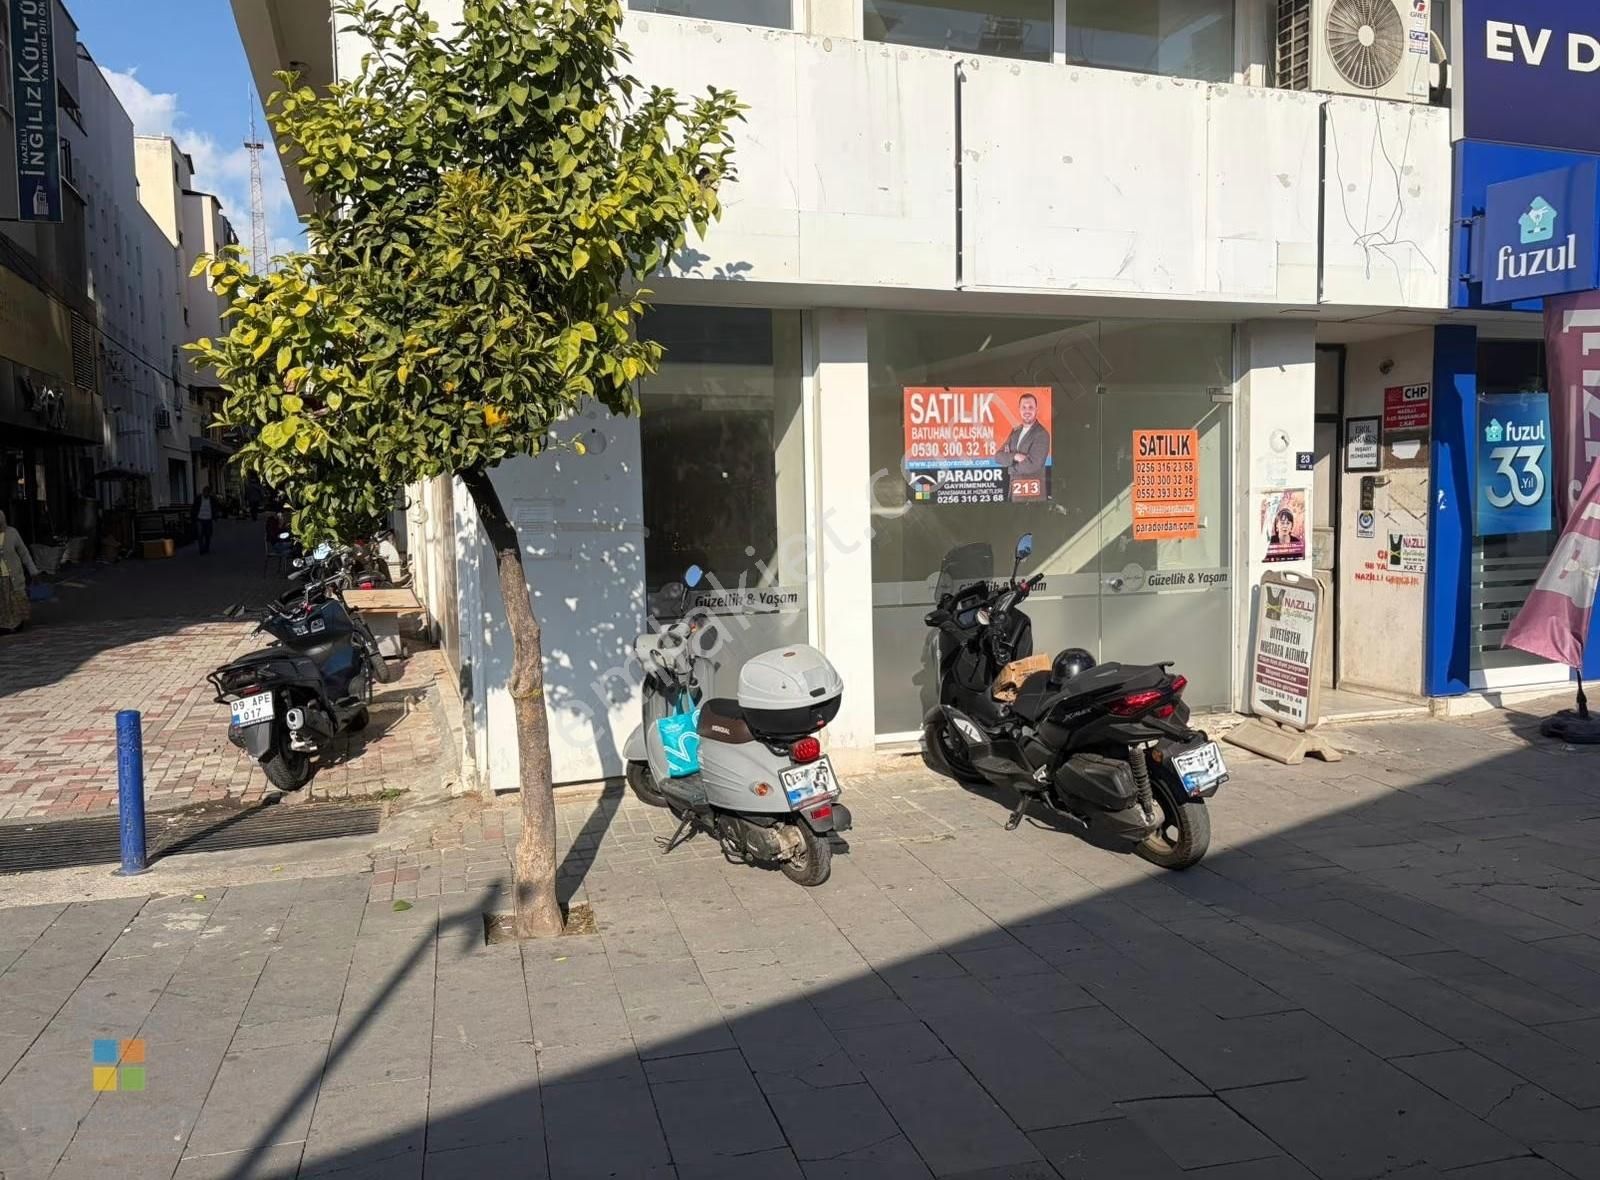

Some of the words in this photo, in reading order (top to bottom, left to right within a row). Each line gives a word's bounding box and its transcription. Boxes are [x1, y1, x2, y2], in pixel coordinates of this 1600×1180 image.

[1486, 20, 1552, 66] EV
[1496, 233, 1577, 281] fuzul
[1404, 386, 1427, 399] CHP
[910, 392, 994, 424] SATILIK
[911, 426, 952, 440] BATUHAN
[952, 425, 994, 442] ÇALIŞKAN
[1506, 420, 1546, 441] fuzul
[911, 442, 939, 457] 0530
[942, 442, 963, 457] 300
[966, 441, 980, 456] 32
[983, 441, 997, 456] 18
[1139, 434, 1190, 456] SATILIK
[1300, 454, 1310, 464] 23
[1136, 462, 1155, 473] 0256
[1157, 462, 1171, 473] 316
[1173, 462, 1182, 472] 23
[1184, 461, 1193, 472] 68
[937, 469, 1003, 483] PARADOR
[1136, 475, 1155, 486] 0530
[1157, 475, 1171, 485] 300
[1173, 475, 1182, 485] 32
[1487, 445, 1545, 508] 33
[1012, 481, 1040, 495] 213
[1136, 488, 1155, 499] 0552
[1157, 488, 1171, 498] 393
[1184, 487, 1193, 498] 25
[937, 495, 959, 504] 0256
[961, 495, 978, 503] 316
[980, 494, 992, 503] 23
[993, 494, 1004, 502] 68
[1148, 573, 1186, 587] Güzellik
[1188, 572, 1195, 584] &
[1197, 572, 1228, 586] Yaşam
[695, 591, 743, 608] Güzellik
[747, 592, 756, 606] &
[759, 592, 798, 607] Yaşam
[233, 700, 245, 711] 09
[252, 694, 271, 706] APE
[243, 707, 261, 720] 017
